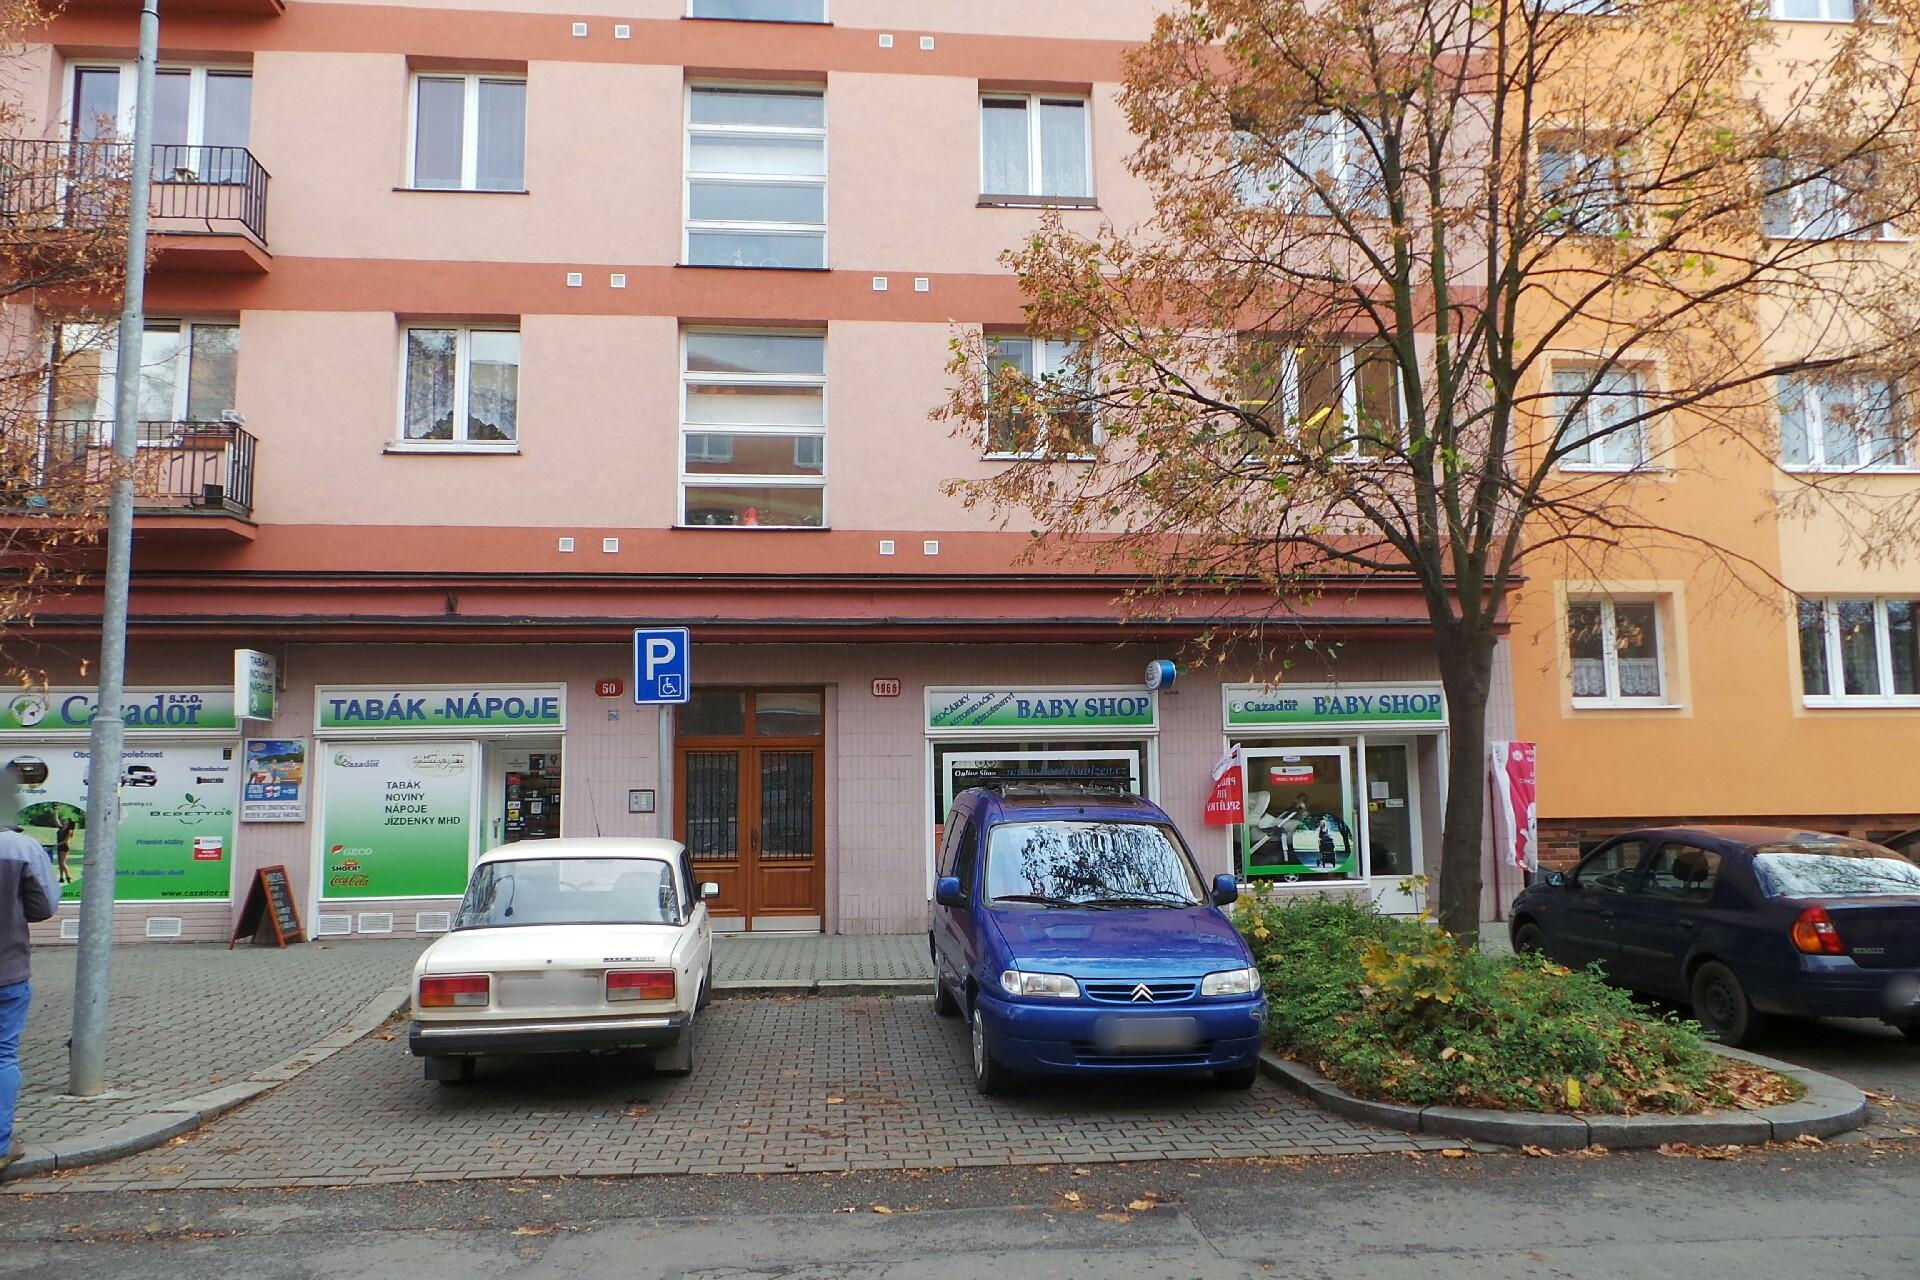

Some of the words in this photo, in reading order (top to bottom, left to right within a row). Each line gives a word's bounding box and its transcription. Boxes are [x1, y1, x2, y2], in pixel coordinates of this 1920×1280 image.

[646, 638, 676, 681] P
[602, 683, 616, 694] 50
[329, 693, 427, 721] TABÁK
[932, 693, 971, 724] KOČÁRKY
[1016, 699, 1079, 719] BABY
[1084, 697, 1150, 718] SHOP
[1244, 700, 1298, 712] Cazador
[1313, 695, 1373, 715] BABY
[1379, 694, 1441, 714] SHOP
[385, 793, 425, 802] NOVINY
[385, 802, 428, 814] NÁPOJE
[384, 815, 435, 826] JÍZDENKY
[438, 816, 461, 825] MHD
[161, 889, 229, 898] www.cazador.cz
